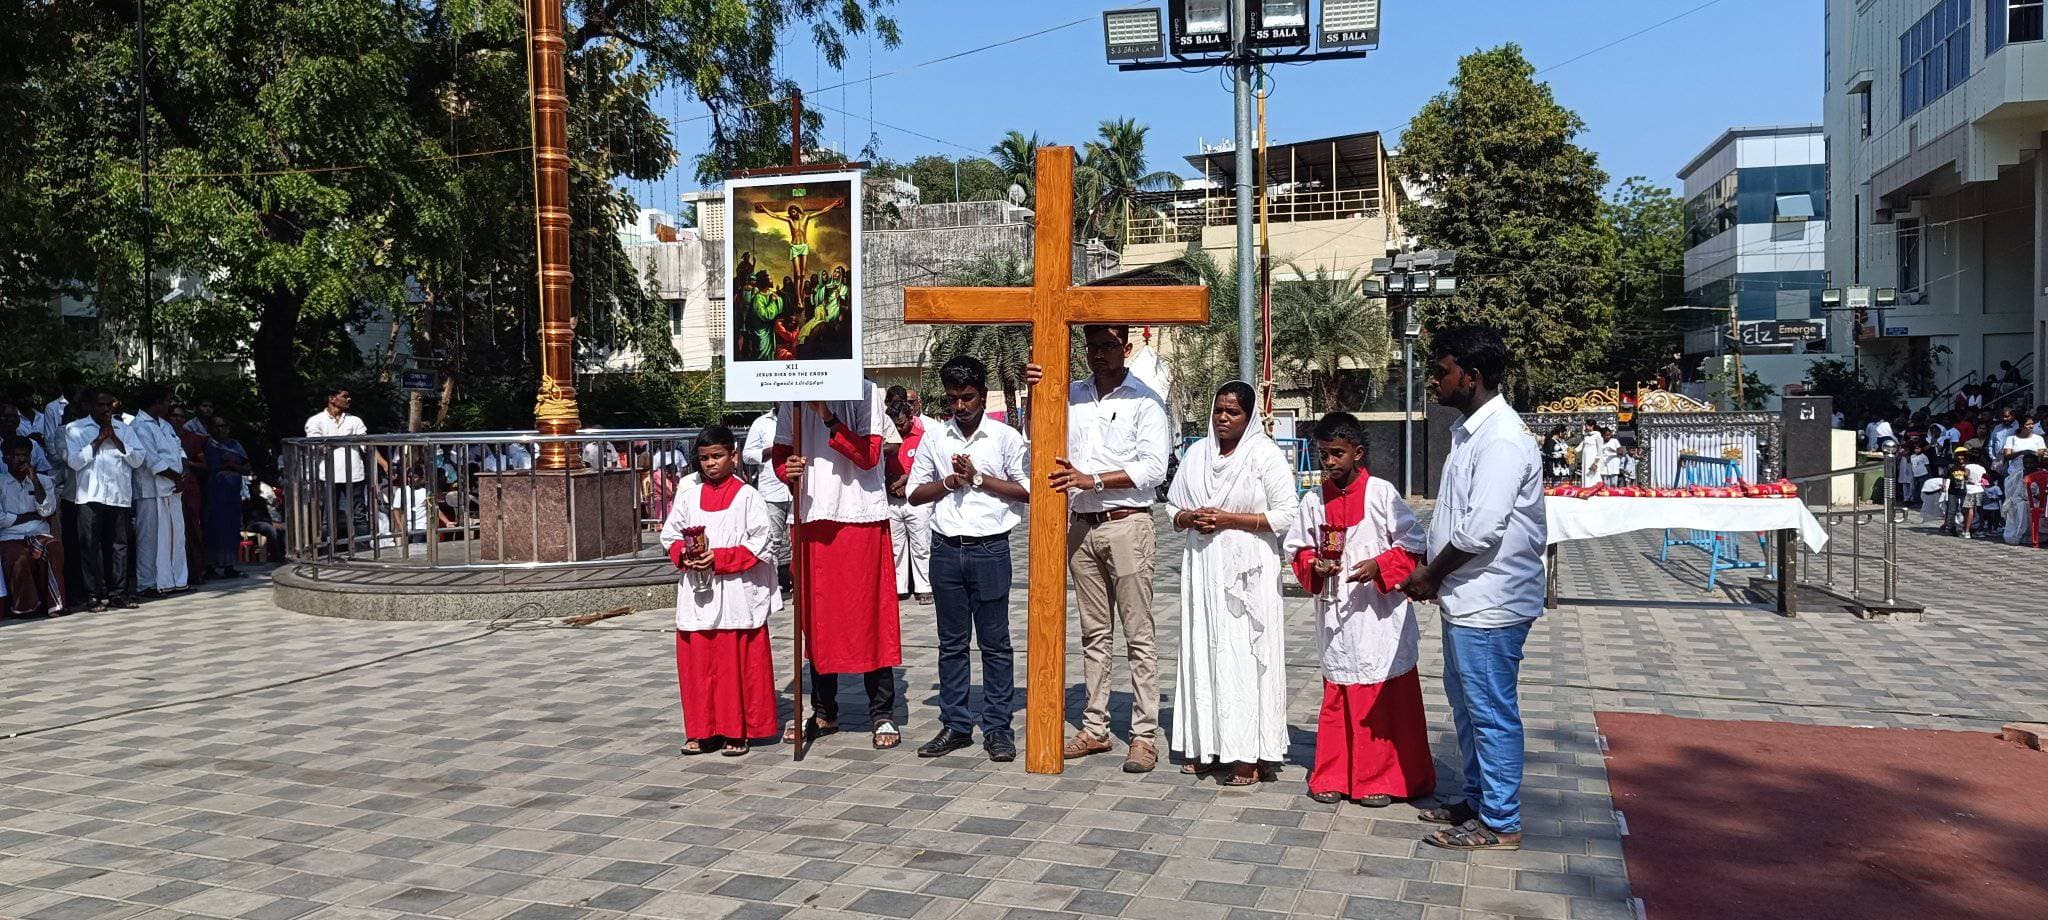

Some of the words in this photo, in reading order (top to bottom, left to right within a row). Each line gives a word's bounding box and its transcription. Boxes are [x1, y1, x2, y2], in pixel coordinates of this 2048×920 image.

[1180, 35, 1193, 46] SS
[1195, 33, 1220, 45] BALA
[1256, 29, 1270, 40] SS
[1272, 27, 1298, 39] BALA
[1326, 32, 1339, 43] SS
[1342, 31, 1367, 42] BALA
[1778, 324, 1816, 335] Emerge
